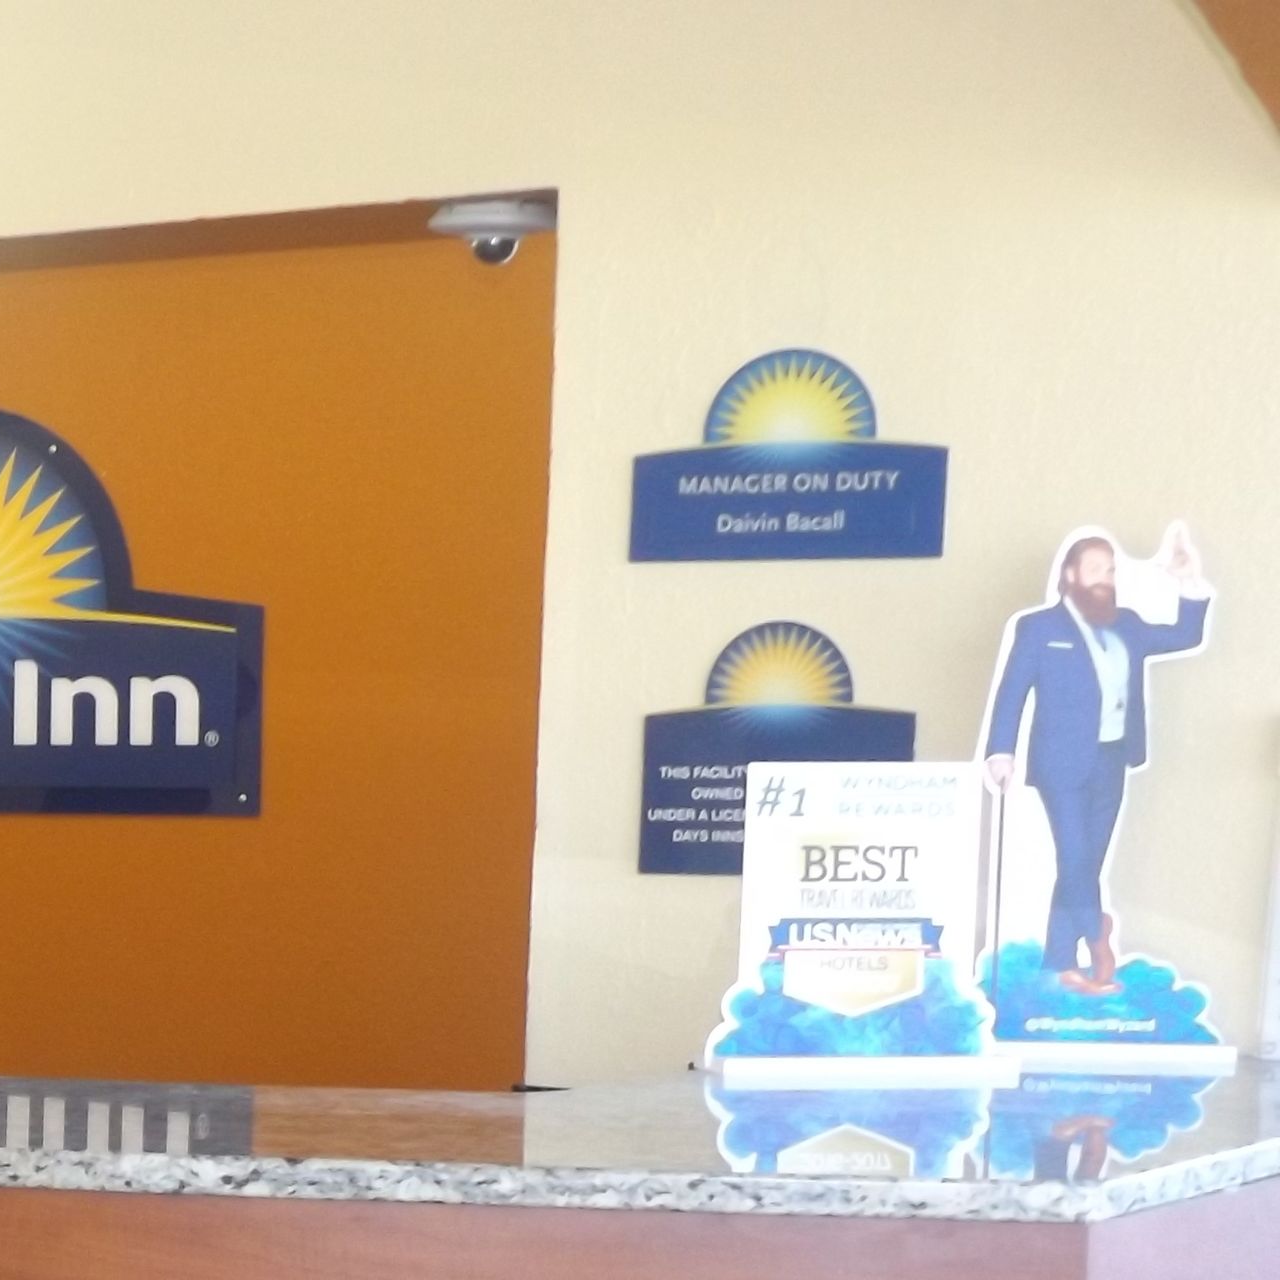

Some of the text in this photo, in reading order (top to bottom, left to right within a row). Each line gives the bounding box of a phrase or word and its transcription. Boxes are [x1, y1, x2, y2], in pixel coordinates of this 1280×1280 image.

[678, 469, 900, 495] MANAGER ON DUTY
[716, 509, 845, 533] Daivin Bacall
[659, 766, 690, 779] THIS
[691, 787, 744, 800] OWNED
[757, 776, 806, 817] #1
[647, 808, 696, 821] UNDER
[698, 808, 708, 821] A
[672, 829, 708, 842] DAYS
[800, 845, 918, 882] BEST
[821, 956, 889, 972] HOTELS
